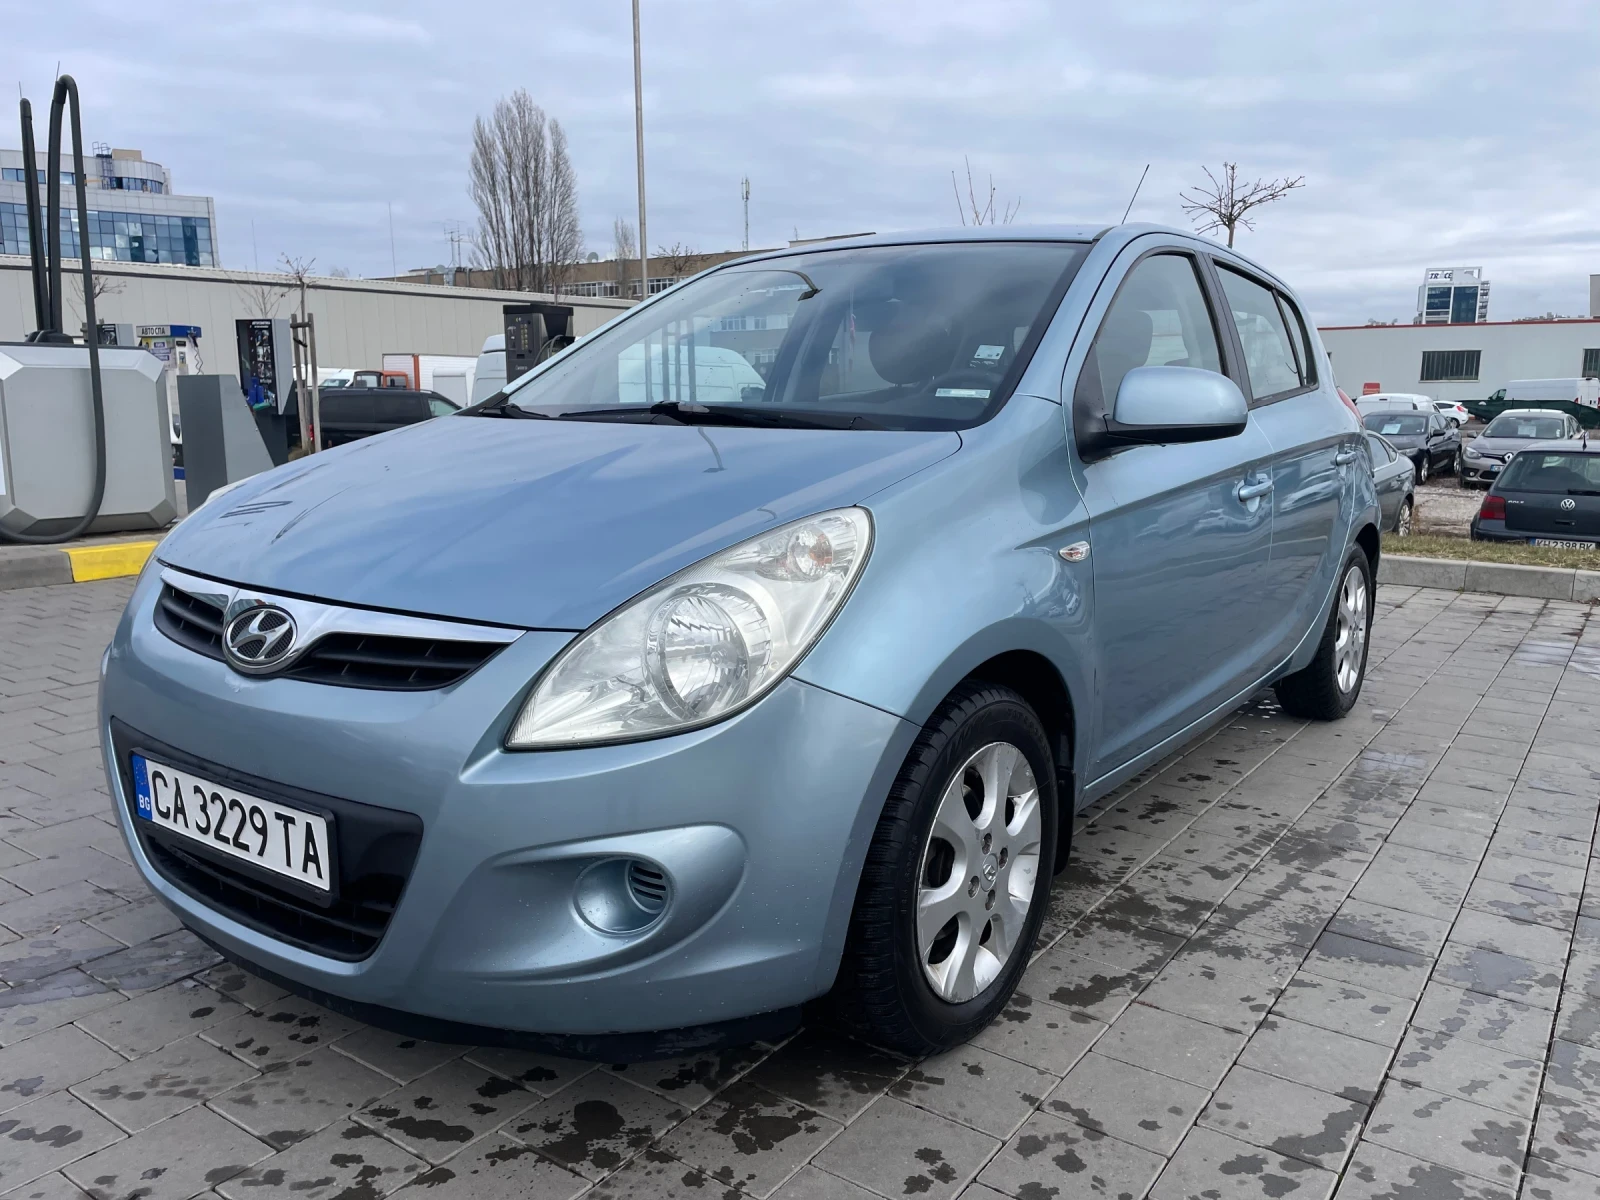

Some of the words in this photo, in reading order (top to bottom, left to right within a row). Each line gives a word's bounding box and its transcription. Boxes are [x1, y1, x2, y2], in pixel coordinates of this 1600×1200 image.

[141, 327, 154, 335] АВТО
[155, 327, 165, 335] СПА
[138, 793, 151, 811] BG
